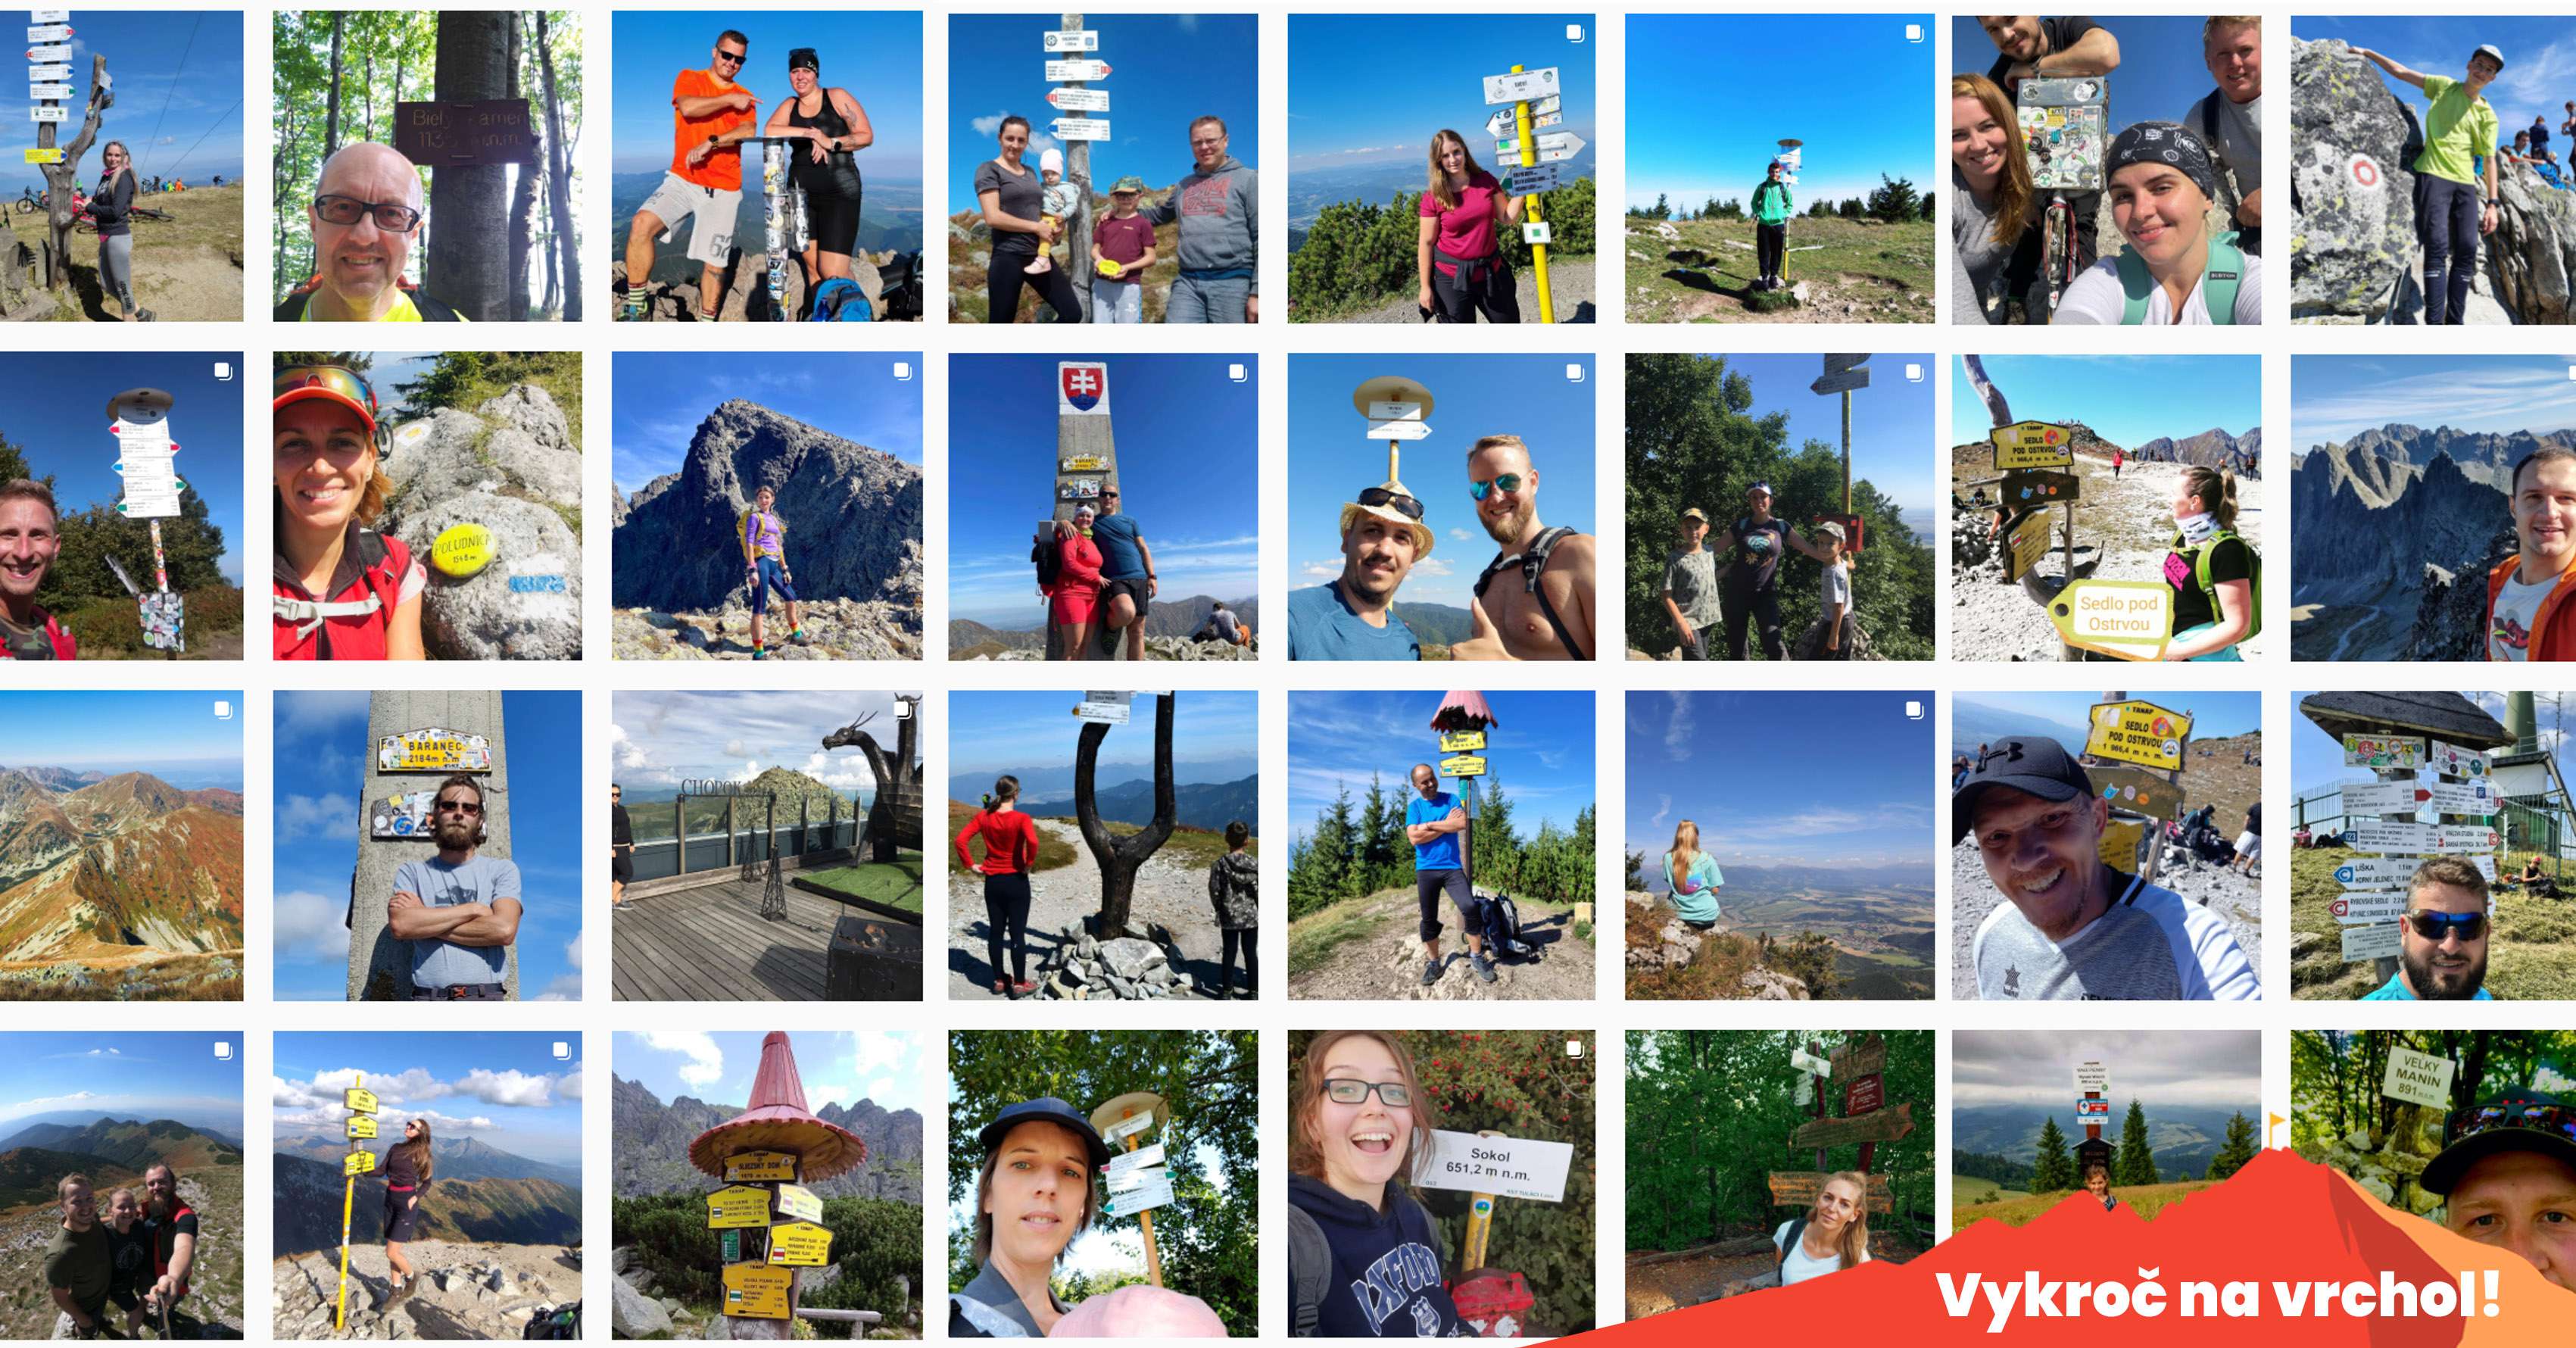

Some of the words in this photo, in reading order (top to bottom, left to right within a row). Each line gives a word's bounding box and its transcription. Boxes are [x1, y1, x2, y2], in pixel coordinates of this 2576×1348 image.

[2029, 445, 2056, 454] OSTRVOU
[2125, 720, 2149, 732] SEDLO
[409, 741, 462, 750] BARANEC
[2109, 731, 2123, 741] POD
[2127, 734, 2163, 748] OSTRVOU
[681, 778, 741, 796] CHOPOK
[2355, 863, 2375, 872] LÍŠKA
[2398, 1083, 2417, 1097] 891
[1470, 1148, 1511, 1162] Sokol
[1446, 1162, 1481, 1175] 651,2
[1486, 1166, 1498, 1176] m
[1502, 1170, 1530, 1181] n.m.
